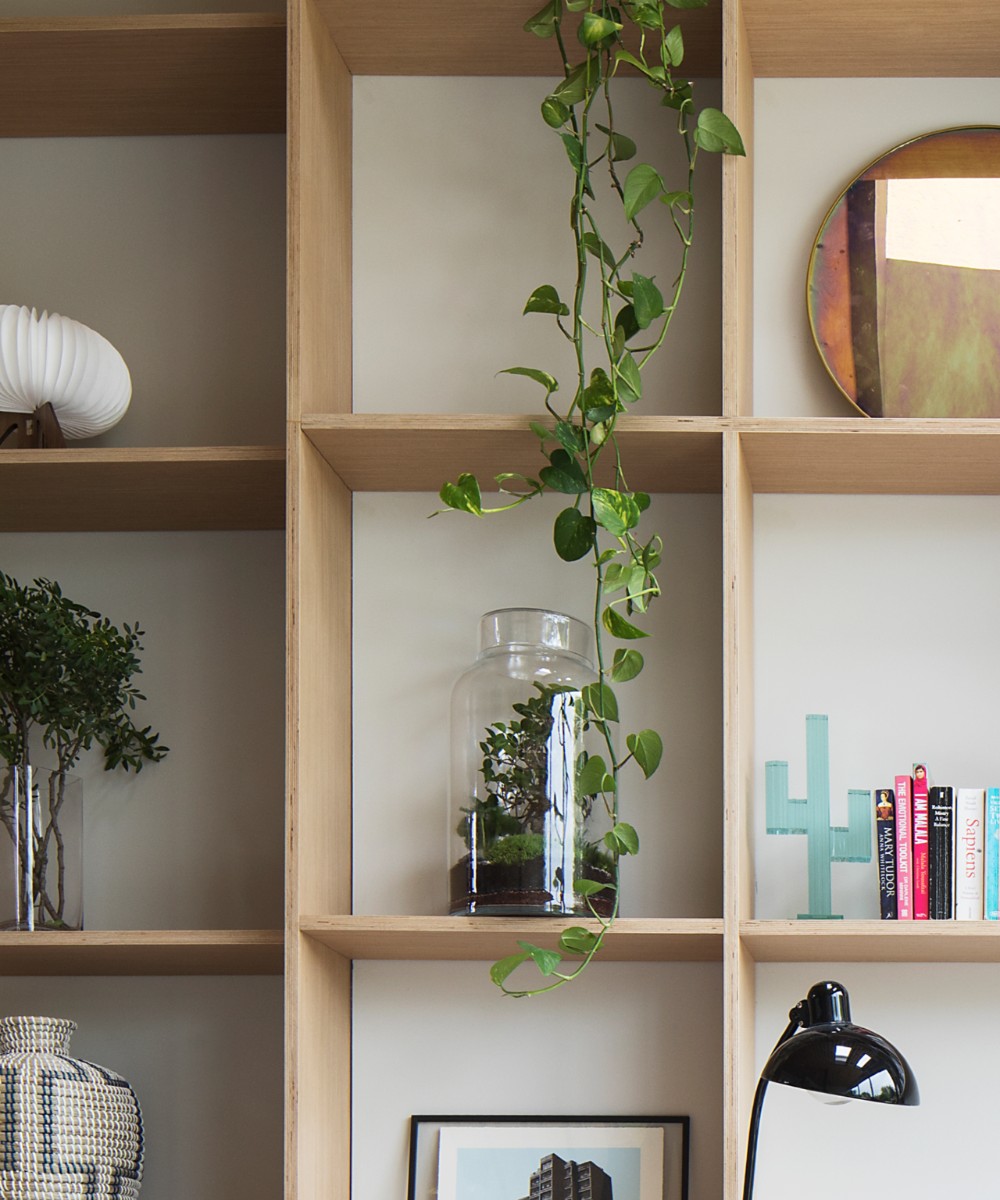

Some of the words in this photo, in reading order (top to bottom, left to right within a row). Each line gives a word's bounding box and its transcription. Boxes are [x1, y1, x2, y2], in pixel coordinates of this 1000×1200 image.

[898, 782, 906, 796] THE
[898, 798, 906, 840] EMOTIONAL
[916, 799, 927, 810] AM
[885, 828, 893, 856] MARY
[915, 814, 927, 844] MALALA
[900, 844, 908, 873] TOOLKIT
[962, 818, 979, 878] Sapiens
[886, 860, 895, 897] TUDOR
